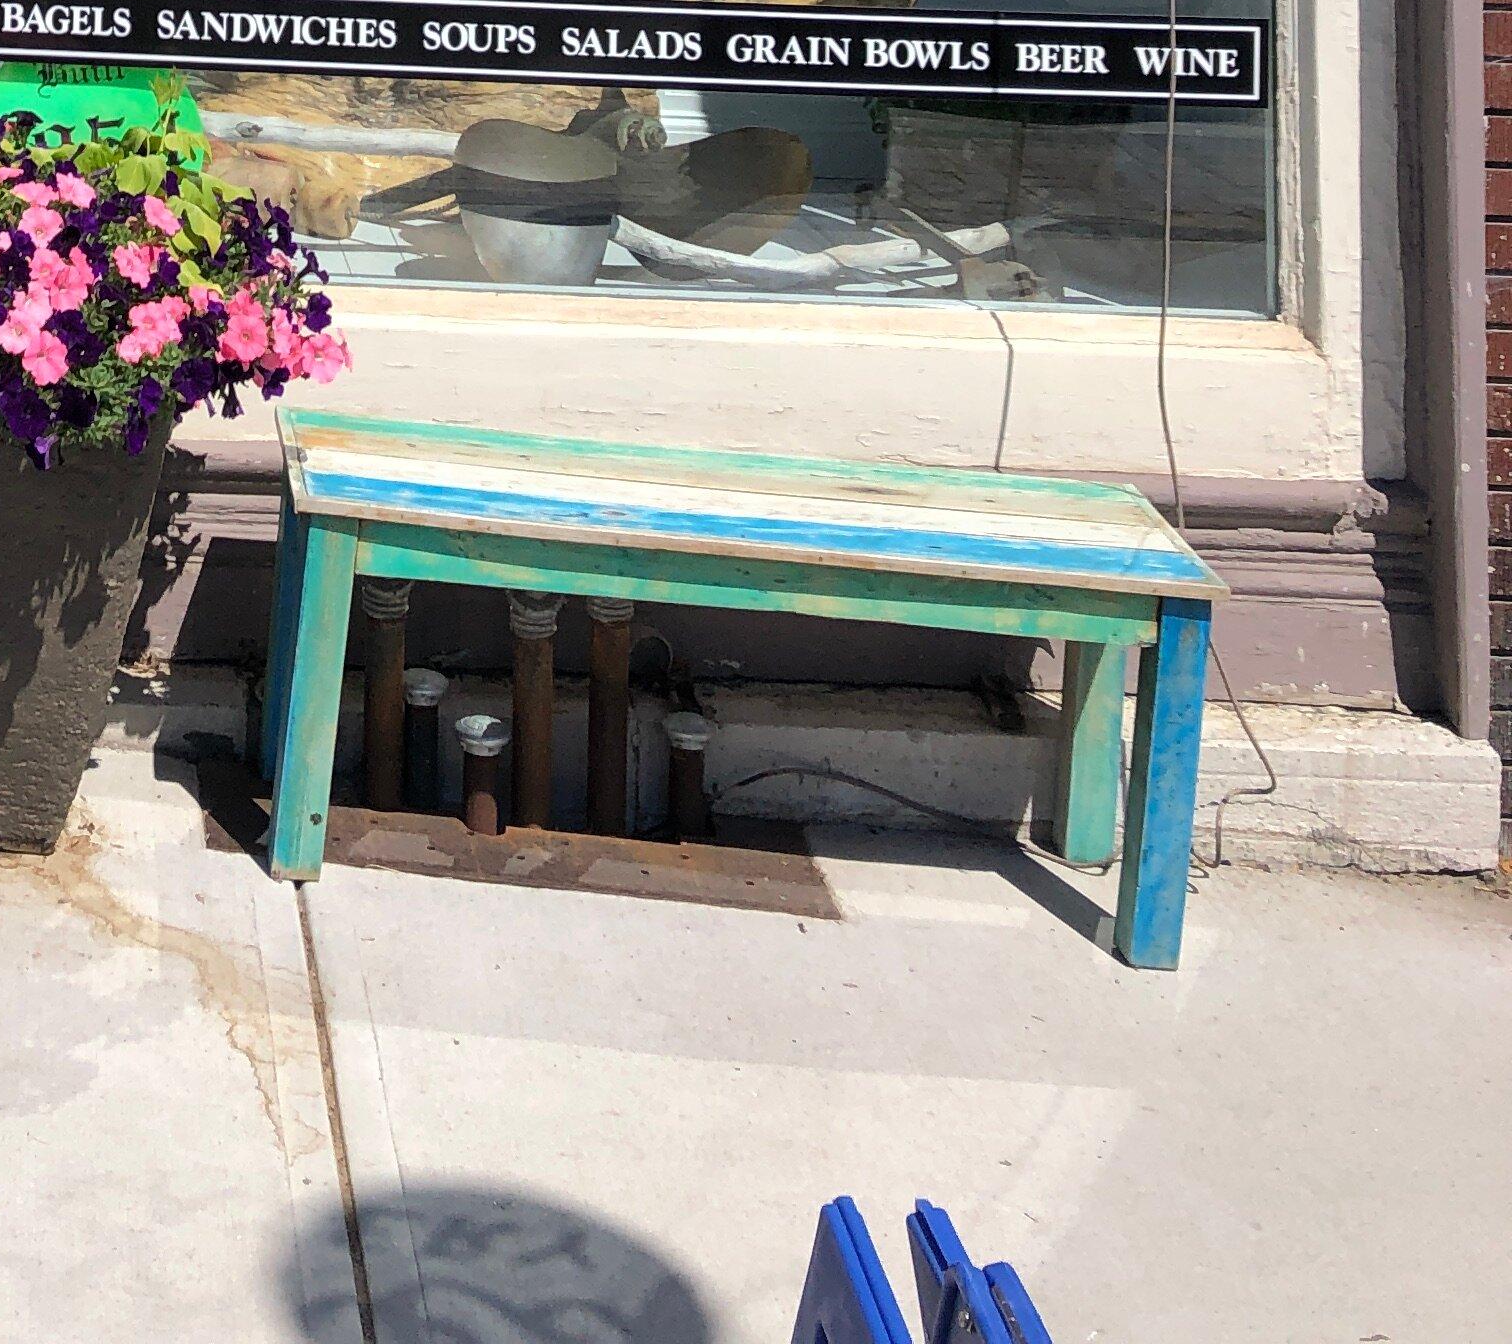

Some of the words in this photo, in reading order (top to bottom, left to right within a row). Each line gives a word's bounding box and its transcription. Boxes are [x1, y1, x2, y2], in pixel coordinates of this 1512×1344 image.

[0, 1, 133, 39] BAGELS
[156, 9, 398, 49] SANDWICHES
[422, 20, 537, 55] SOUPS
[561, 27, 703, 62] SALADS
[725, 32, 852, 68] GRAIN
[863, 37, 990, 72] BOWLS
[1014, 42, 1110, 75] BEER
[1133, 45, 1241, 78] WINE
